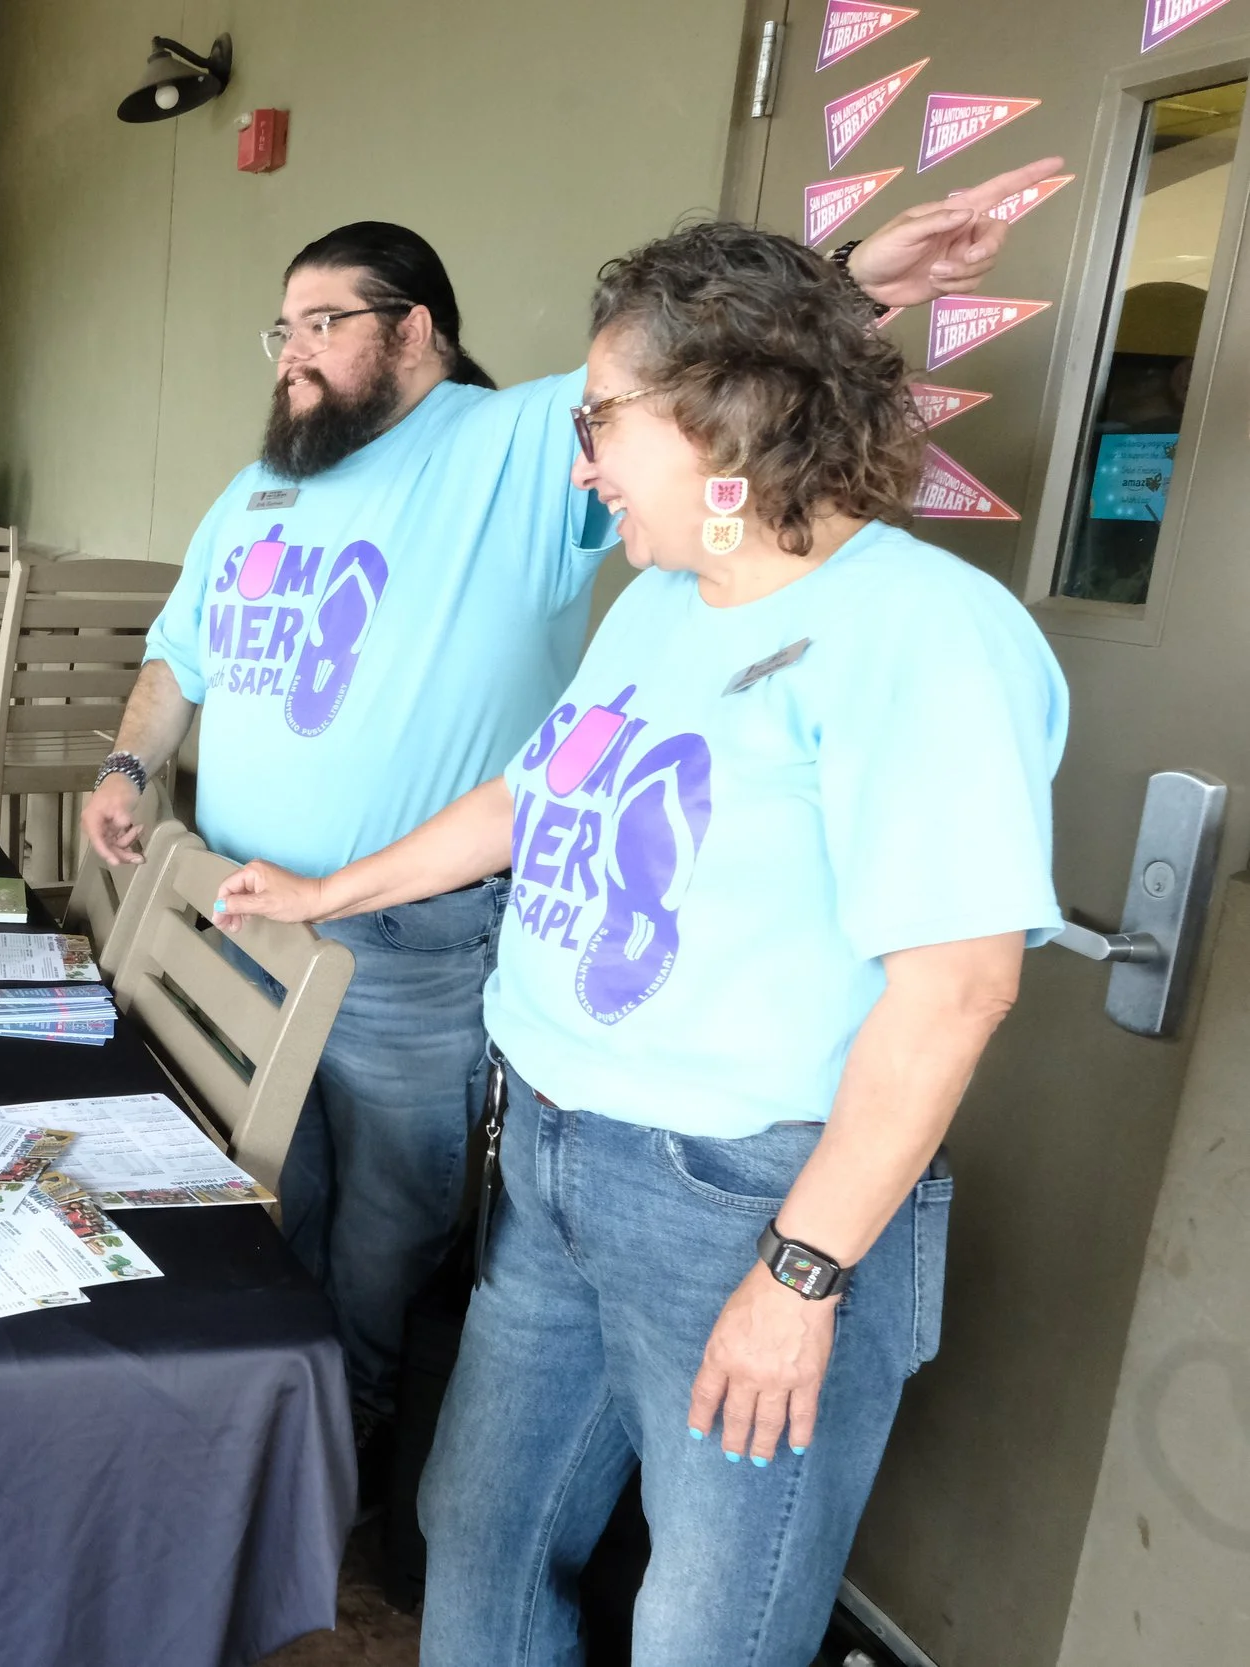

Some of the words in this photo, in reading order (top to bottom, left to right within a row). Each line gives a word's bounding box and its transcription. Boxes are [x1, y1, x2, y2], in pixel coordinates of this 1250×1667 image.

[822, 20, 878, 60] LIBRARY
[829, 12, 840, 28] SAN
[840, 12, 862, 25] ANTONIO
[862, 12, 879, 21] PUBLIC
[831, 109, 842, 129] SAN
[842, 96, 867, 120] ANTONIO
[867, 84, 886, 102] PUBLIC
[833, 90, 886, 156] LIBRARY
[931, 108, 944, 127] SAN
[944, 107, 971, 124] ANTONIO
[971, 105, 992, 116] PUBLIC
[926, 114, 991, 159] LIBRARY
[810, 195, 821, 213] SAN
[821, 188, 844, 208] ANTONIO
[844, 182, 862, 196] PUBLIC
[810, 189, 862, 241] LIBRARY
[934, 315, 1000, 359] LIBRARY
[937, 309, 950, 327] SAN
[950, 307, 978, 324] ANTONIO
[979, 307, 1001, 317] PUBLIC
[228, 663, 284, 696] SAPL
[302, 720, 330, 735] PUBLIC
[328, 683, 348, 719] LIBRARY
[514, 883, 583, 951] SAPL
[588, 927, 609, 953] SAN
[577, 955, 594, 1015] ANTONIO
[638, 951, 674, 1001] LIBRARY
[596, 1001, 637, 1024] PUBLIC
